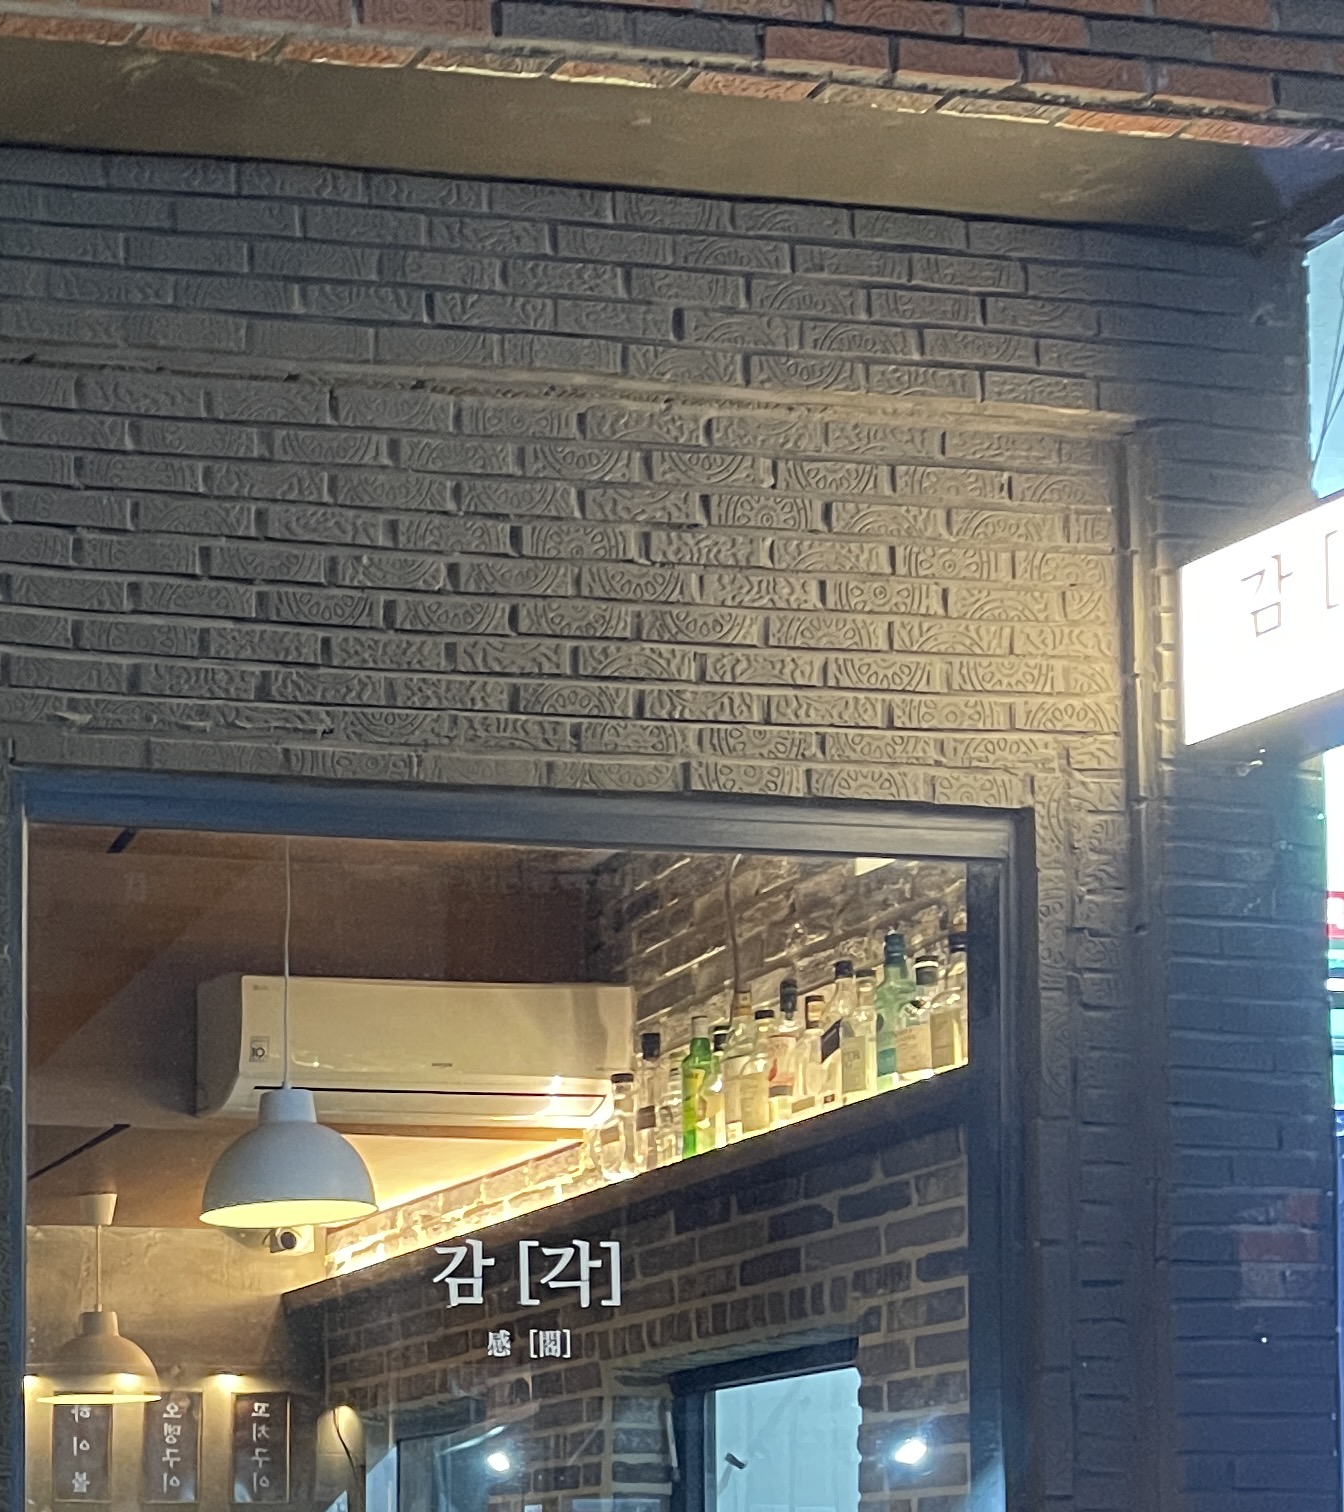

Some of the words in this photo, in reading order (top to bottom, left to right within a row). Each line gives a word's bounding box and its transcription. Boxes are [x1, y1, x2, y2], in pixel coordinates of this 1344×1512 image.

[1241, 554, 1293, 637] 감
[432, 1239, 495, 1308] 감
[487, 1329, 511, 1357] 感
